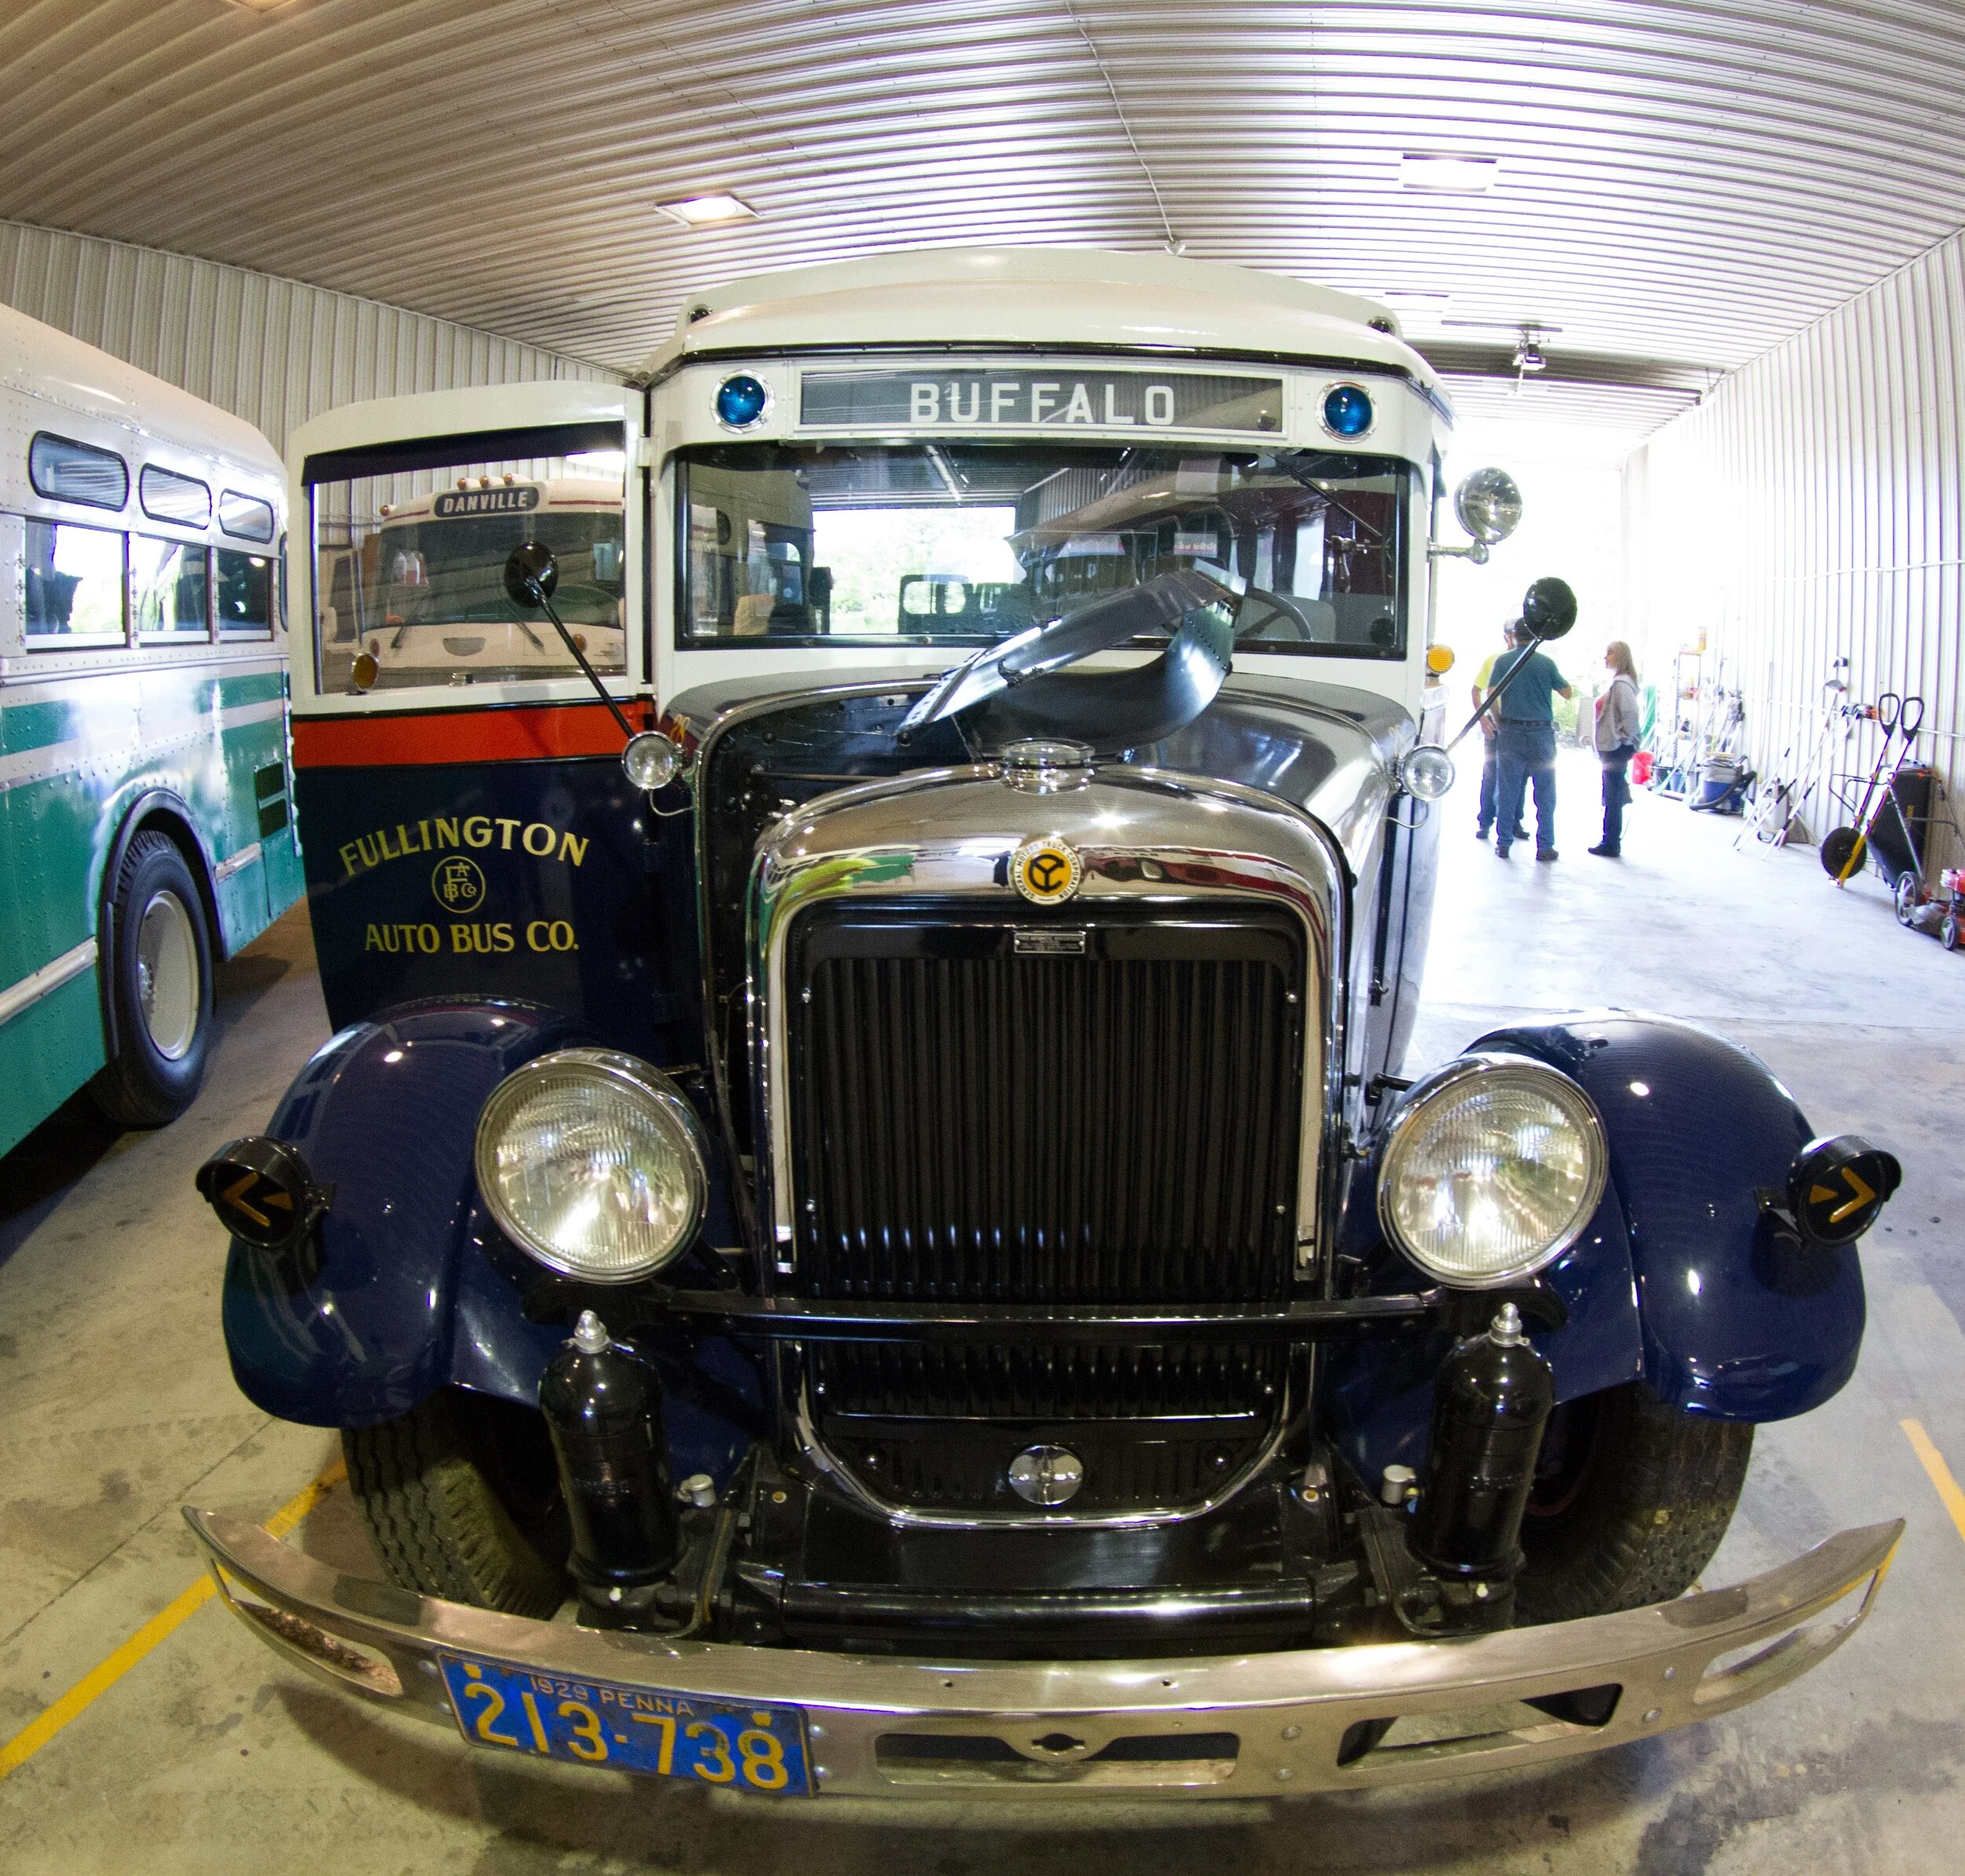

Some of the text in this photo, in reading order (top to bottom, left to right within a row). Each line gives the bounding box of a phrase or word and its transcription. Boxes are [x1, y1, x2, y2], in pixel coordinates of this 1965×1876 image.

[909, 383, 1176, 426] BUFFALO
[443, 490, 529, 514] DANVILLE
[338, 816, 590, 878] FULLINGTON
[365, 920, 580, 953] AUTO BUS CO.
[530, 1676, 694, 1717] 1929 PENNA
[465, 1682, 788, 1790] 213-738
